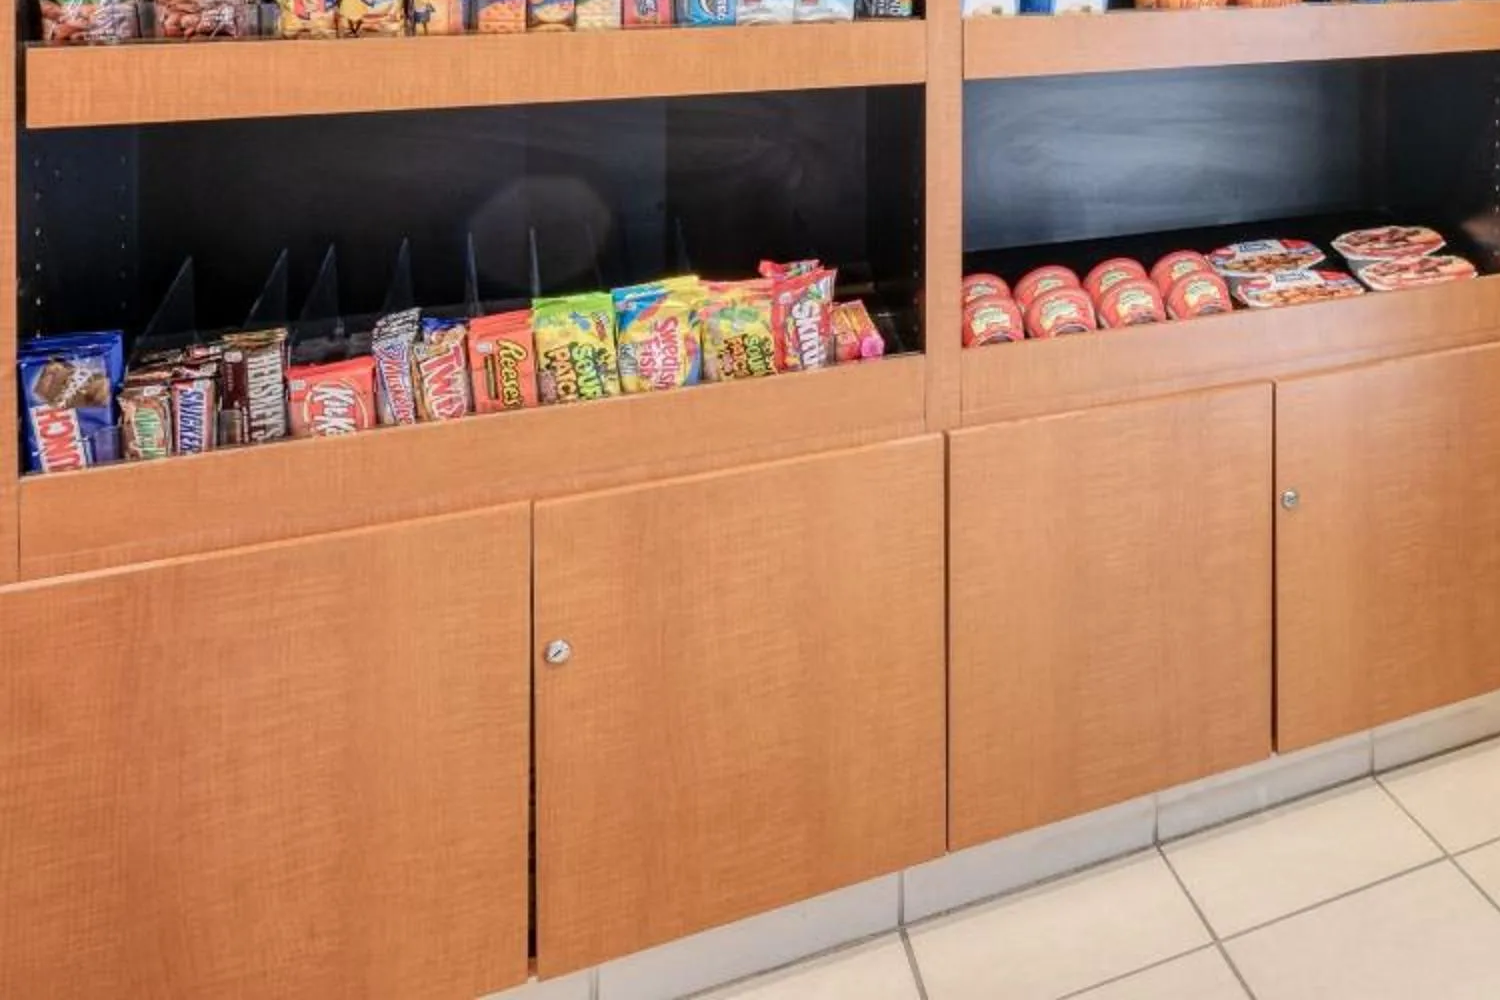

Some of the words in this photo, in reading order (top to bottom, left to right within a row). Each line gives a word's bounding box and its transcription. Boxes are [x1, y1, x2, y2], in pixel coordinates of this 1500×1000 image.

[496, 338, 528, 407] Reese's
[654, 315, 680, 391] Swedish
[177, 388, 204, 455] SNICKER
[247, 352, 286, 442] HERSHEY'S
[311, 385, 357, 437] KitK
[34, 405, 82, 473] UNCH
